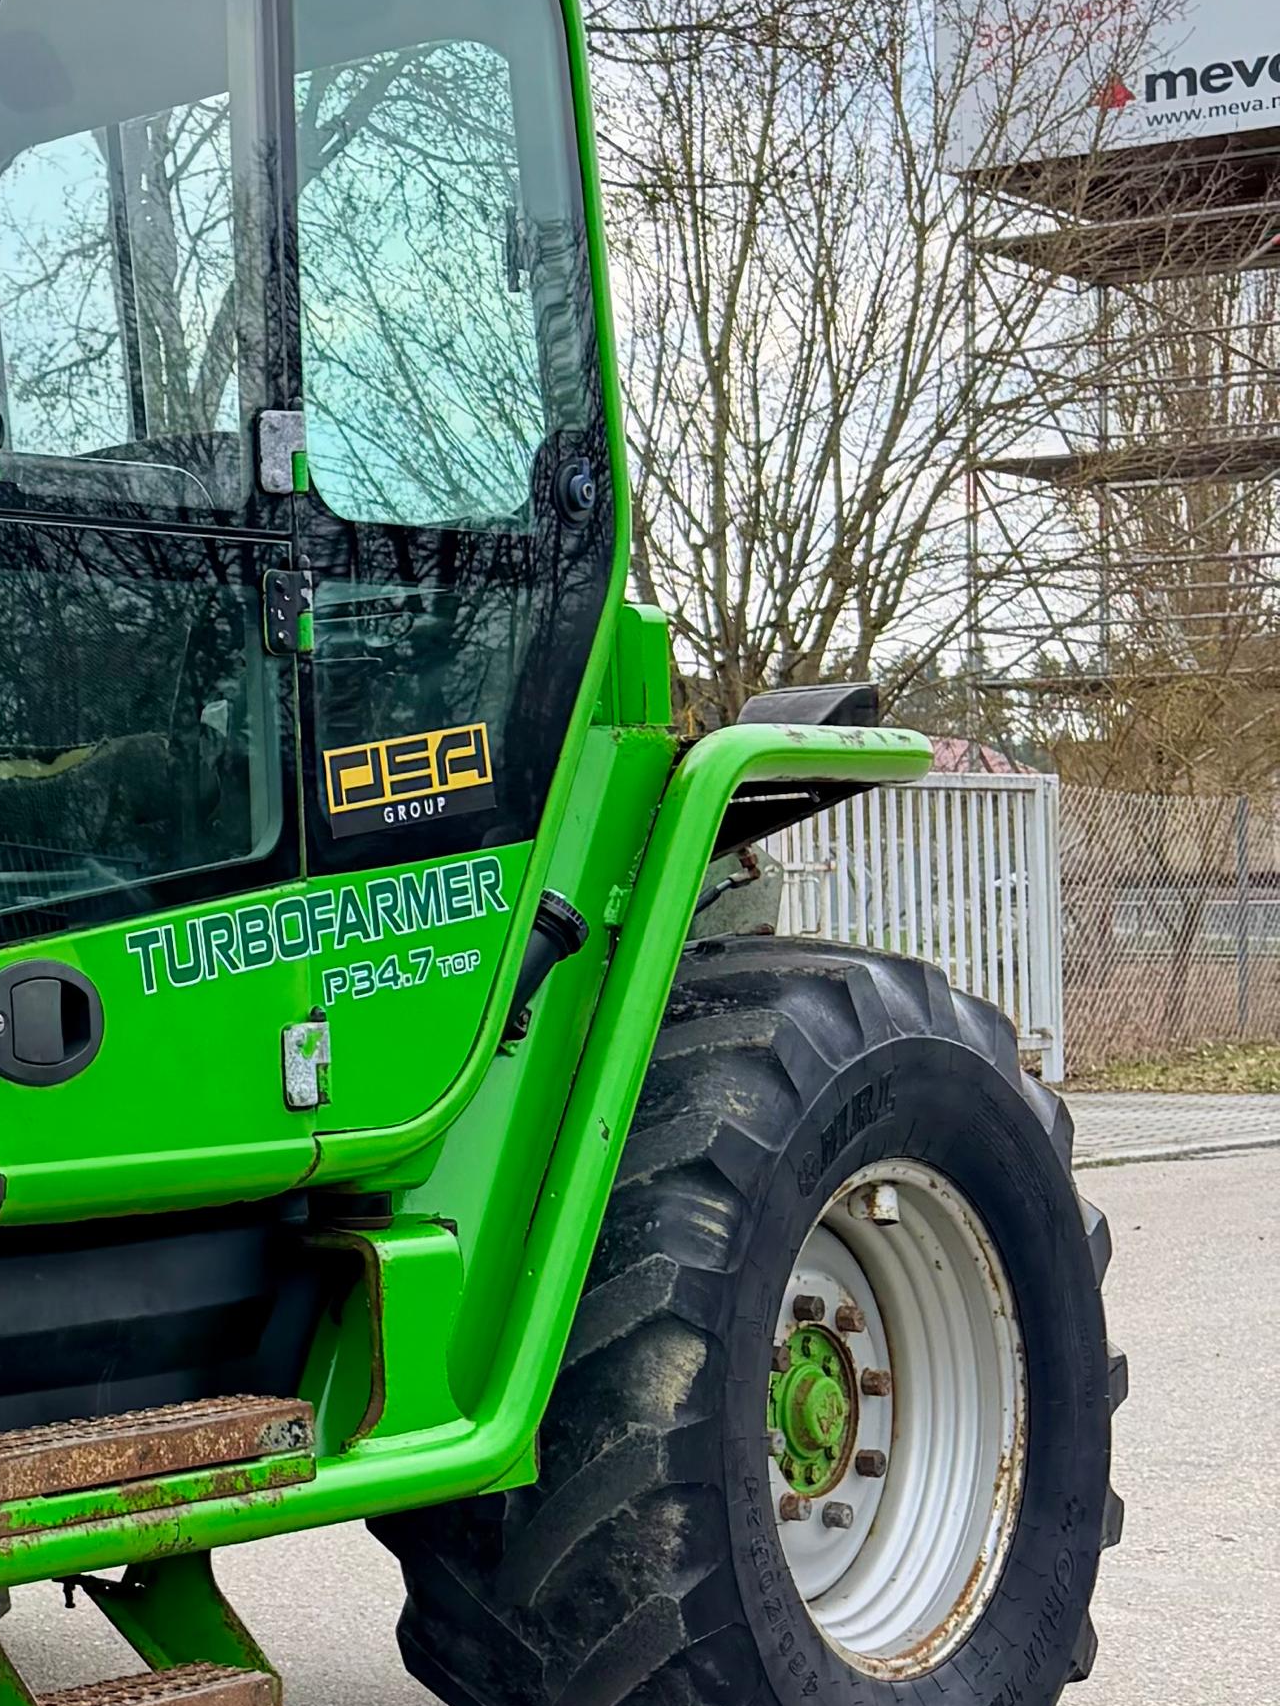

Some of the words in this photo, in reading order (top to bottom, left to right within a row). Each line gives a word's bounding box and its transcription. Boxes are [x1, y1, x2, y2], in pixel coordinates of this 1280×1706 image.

[383, 796, 446, 824] GROUP
[125, 855, 509, 995] TURBOFARMER
[321, 946, 434, 1006] P34.7
[438, 949, 481, 979] TOP
